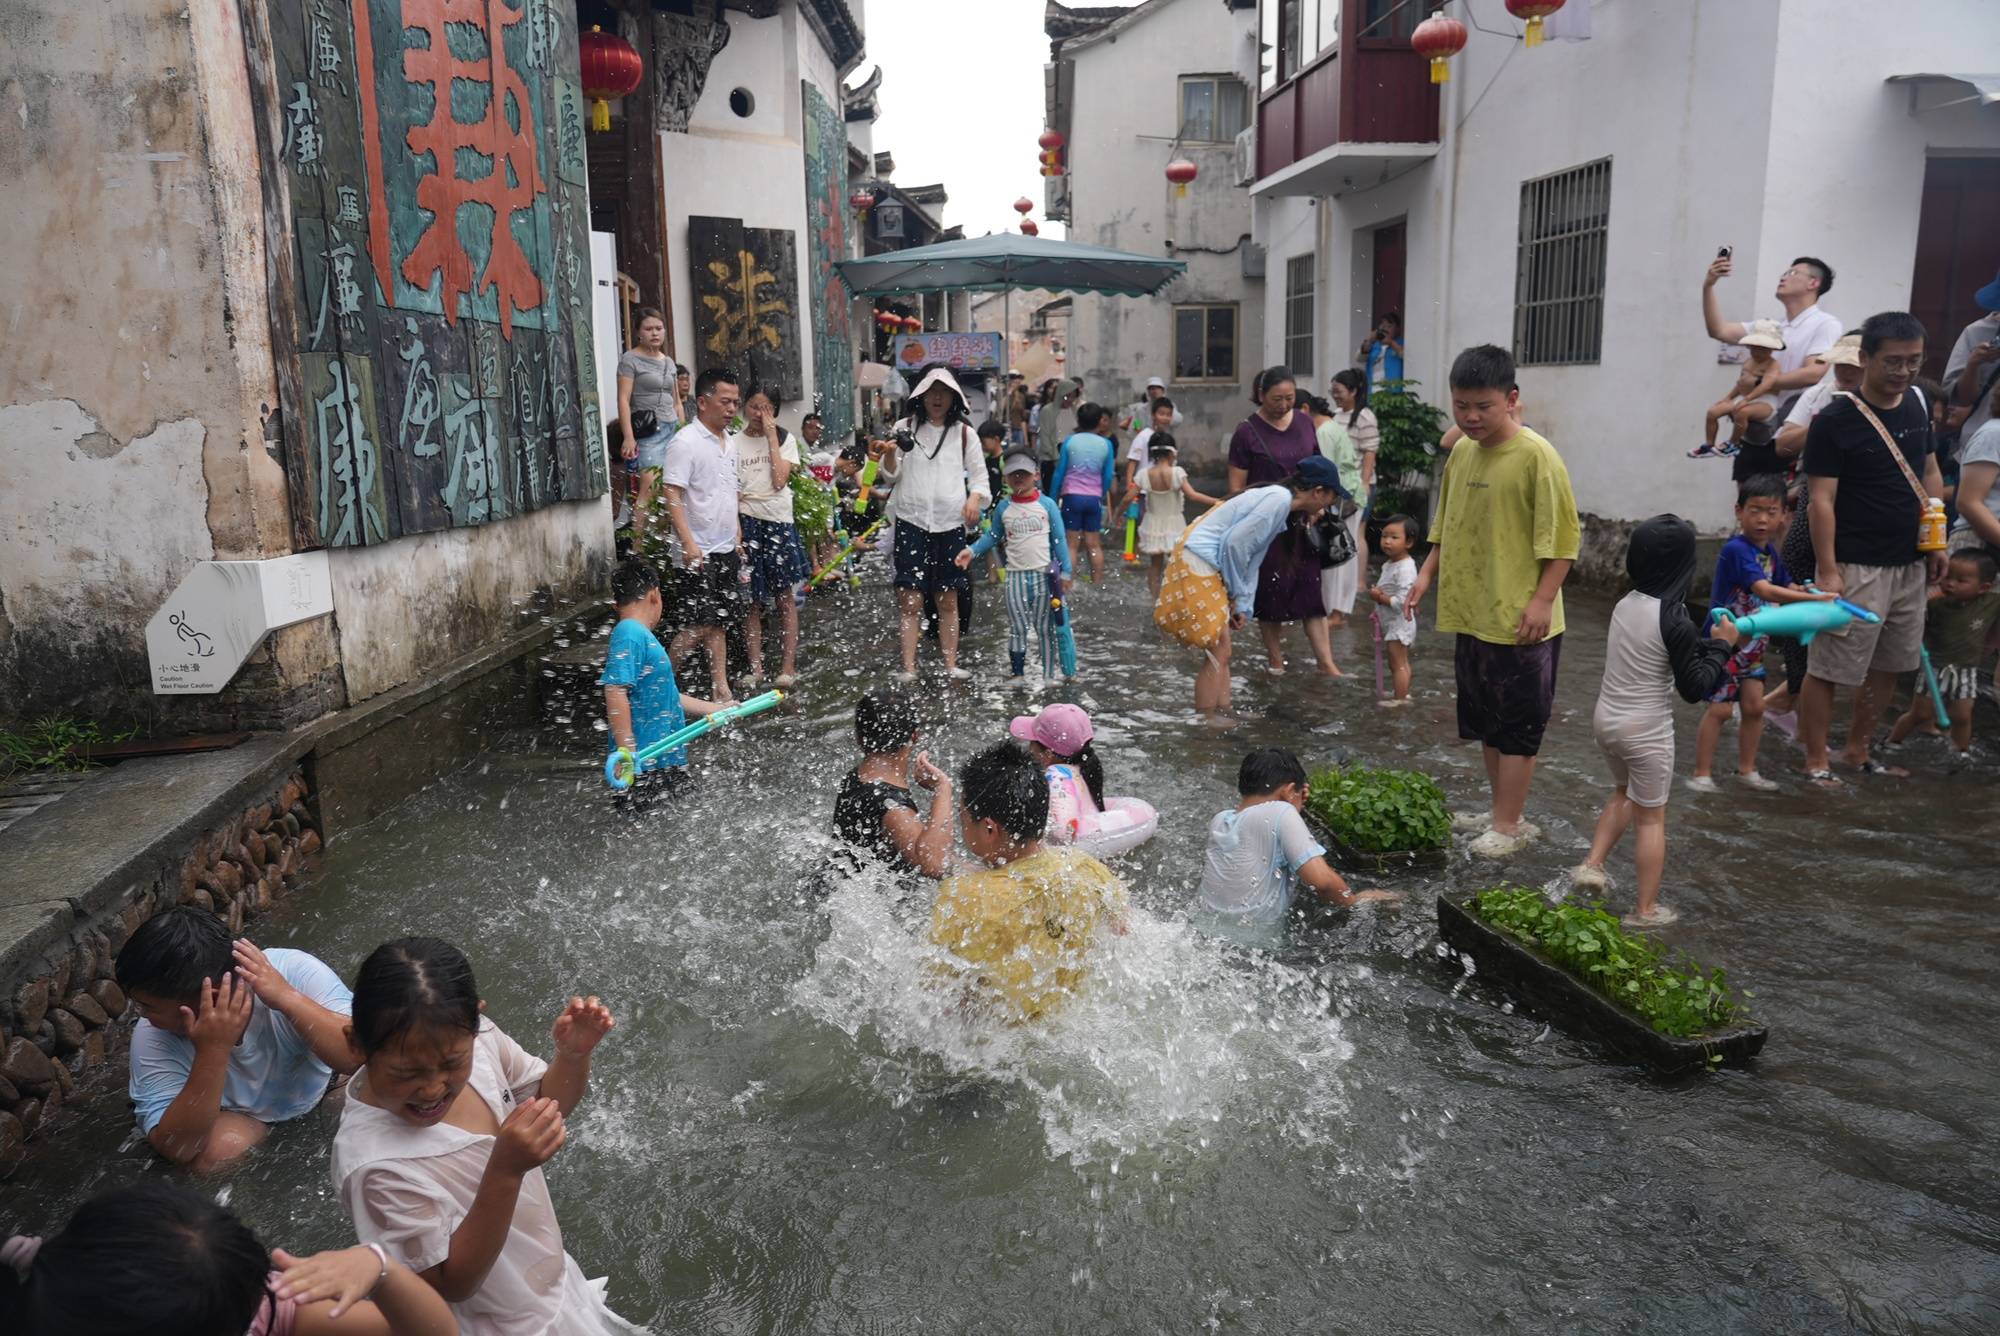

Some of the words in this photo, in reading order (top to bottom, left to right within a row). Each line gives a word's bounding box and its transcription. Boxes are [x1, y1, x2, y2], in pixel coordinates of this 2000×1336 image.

[928, 335, 993, 358] 绵绵冰
[158, 663, 201, 673] 小心地滑
